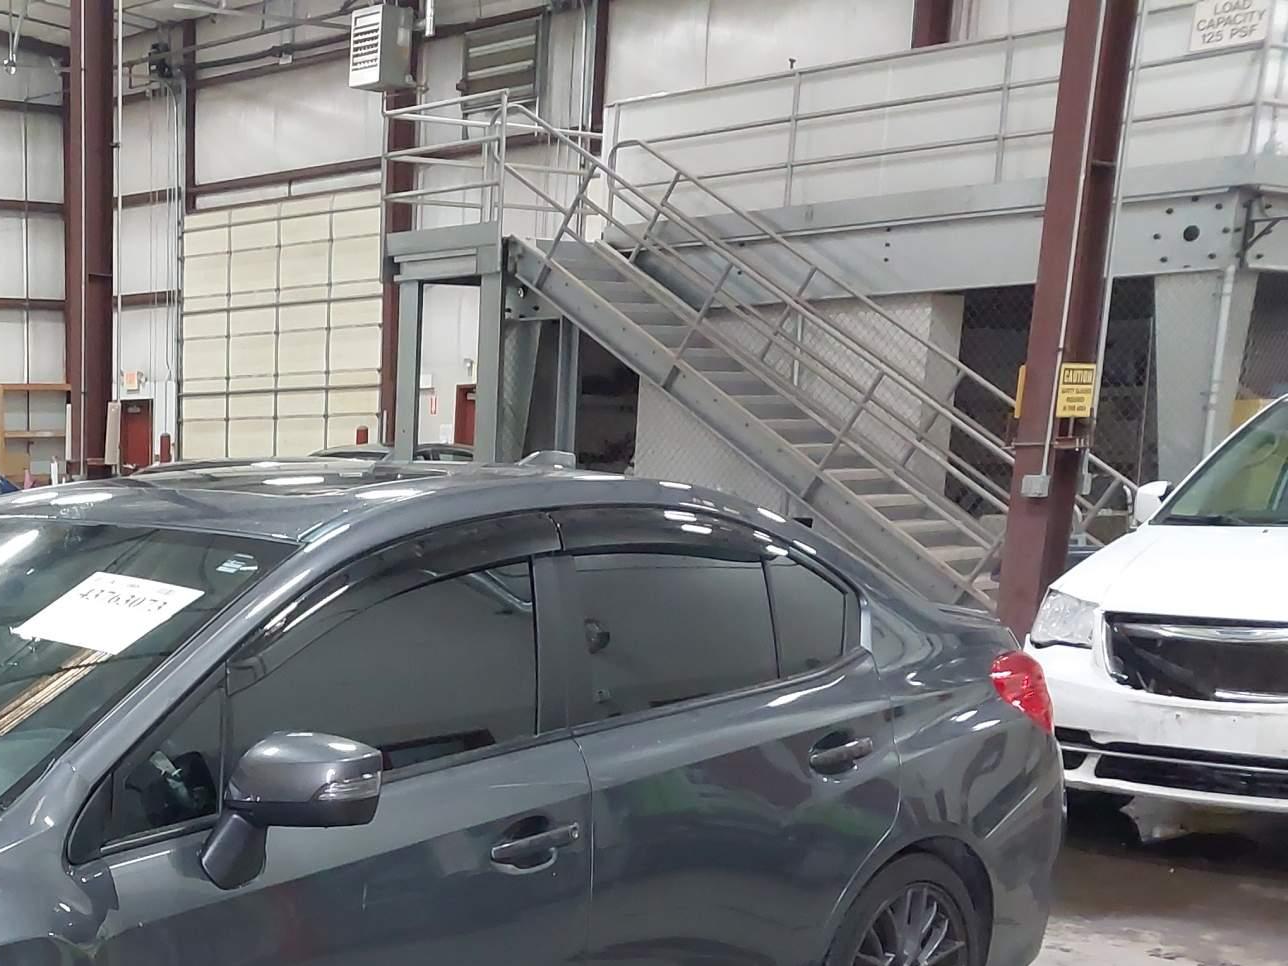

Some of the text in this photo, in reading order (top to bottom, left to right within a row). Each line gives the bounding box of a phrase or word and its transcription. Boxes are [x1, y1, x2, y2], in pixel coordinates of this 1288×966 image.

[1214, 0, 1252, 15] LOAD
[1197, 9, 1266, 31] CAPACITY
[1202, 24, 1258, 44] 125 PSF
[1063, 369, 1094, 384] CAUTION
